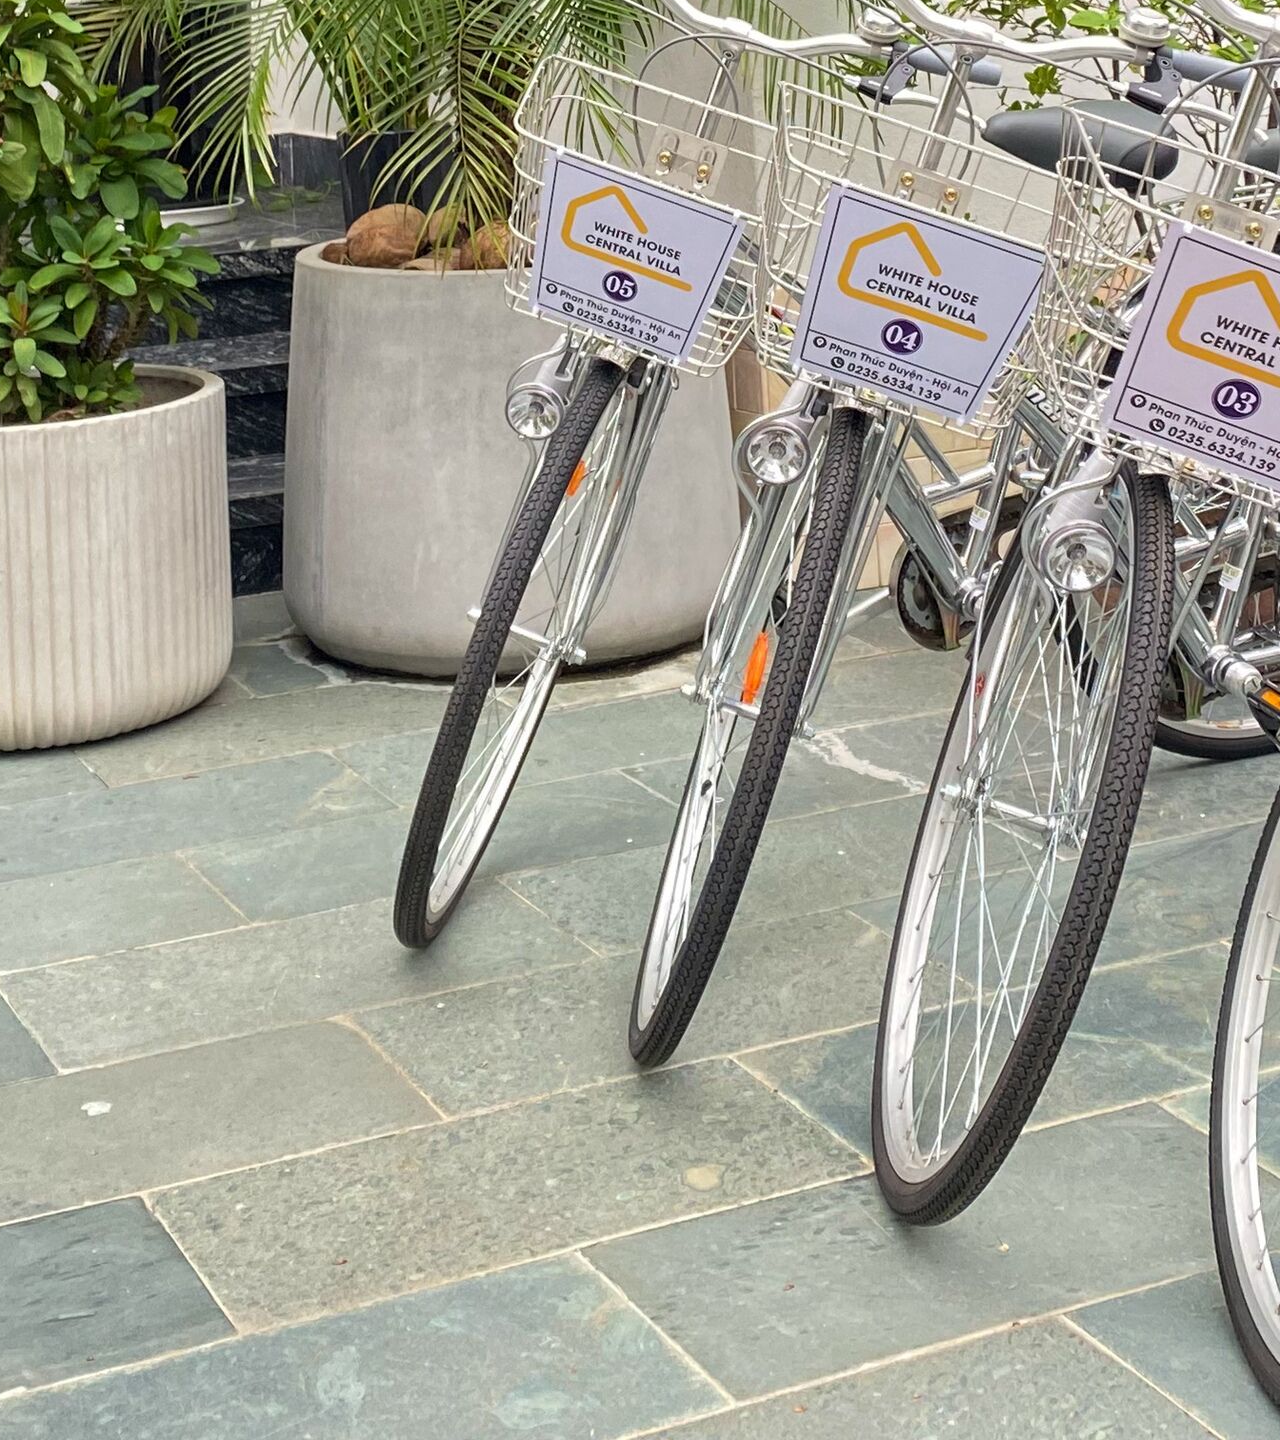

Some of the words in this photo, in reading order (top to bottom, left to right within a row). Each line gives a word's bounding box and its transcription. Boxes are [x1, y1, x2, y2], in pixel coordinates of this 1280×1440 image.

[585, 234, 642, 261] CENTRAL
[647, 255, 681, 276] VILLA
[594, 221, 634, 243] WHITE
[637, 237, 681, 260] HOUSE
[605, 275, 636, 297] 05
[866, 279, 931, 309] CENTRAL
[938, 301, 977, 324] VILLA
[878, 263, 924, 287] WHITE
[928, 280, 979, 307] HOUSE
[560, 289, 584, 304] Phan
[667, 330, 681, 340] An
[576, 307, 658, 344] 0235.6334.139
[1216, 314, 1270, 345] WHITE
[884, 324, 919, 352] 04
[1200, 331, 1275, 368] CENTRAL
[829, 343, 857, 360] Phan
[860, 351, 886, 369] Thúc
[953, 384, 969, 398] An
[847, 361, 942, 402] 0235.6334.139
[1148, 402, 1181, 422] Phan
[1184, 415, 1215, 434] Thúc
[1216, 385, 1258, 414] 03
[1168, 426, 1276, 473] 0235.6334.139
